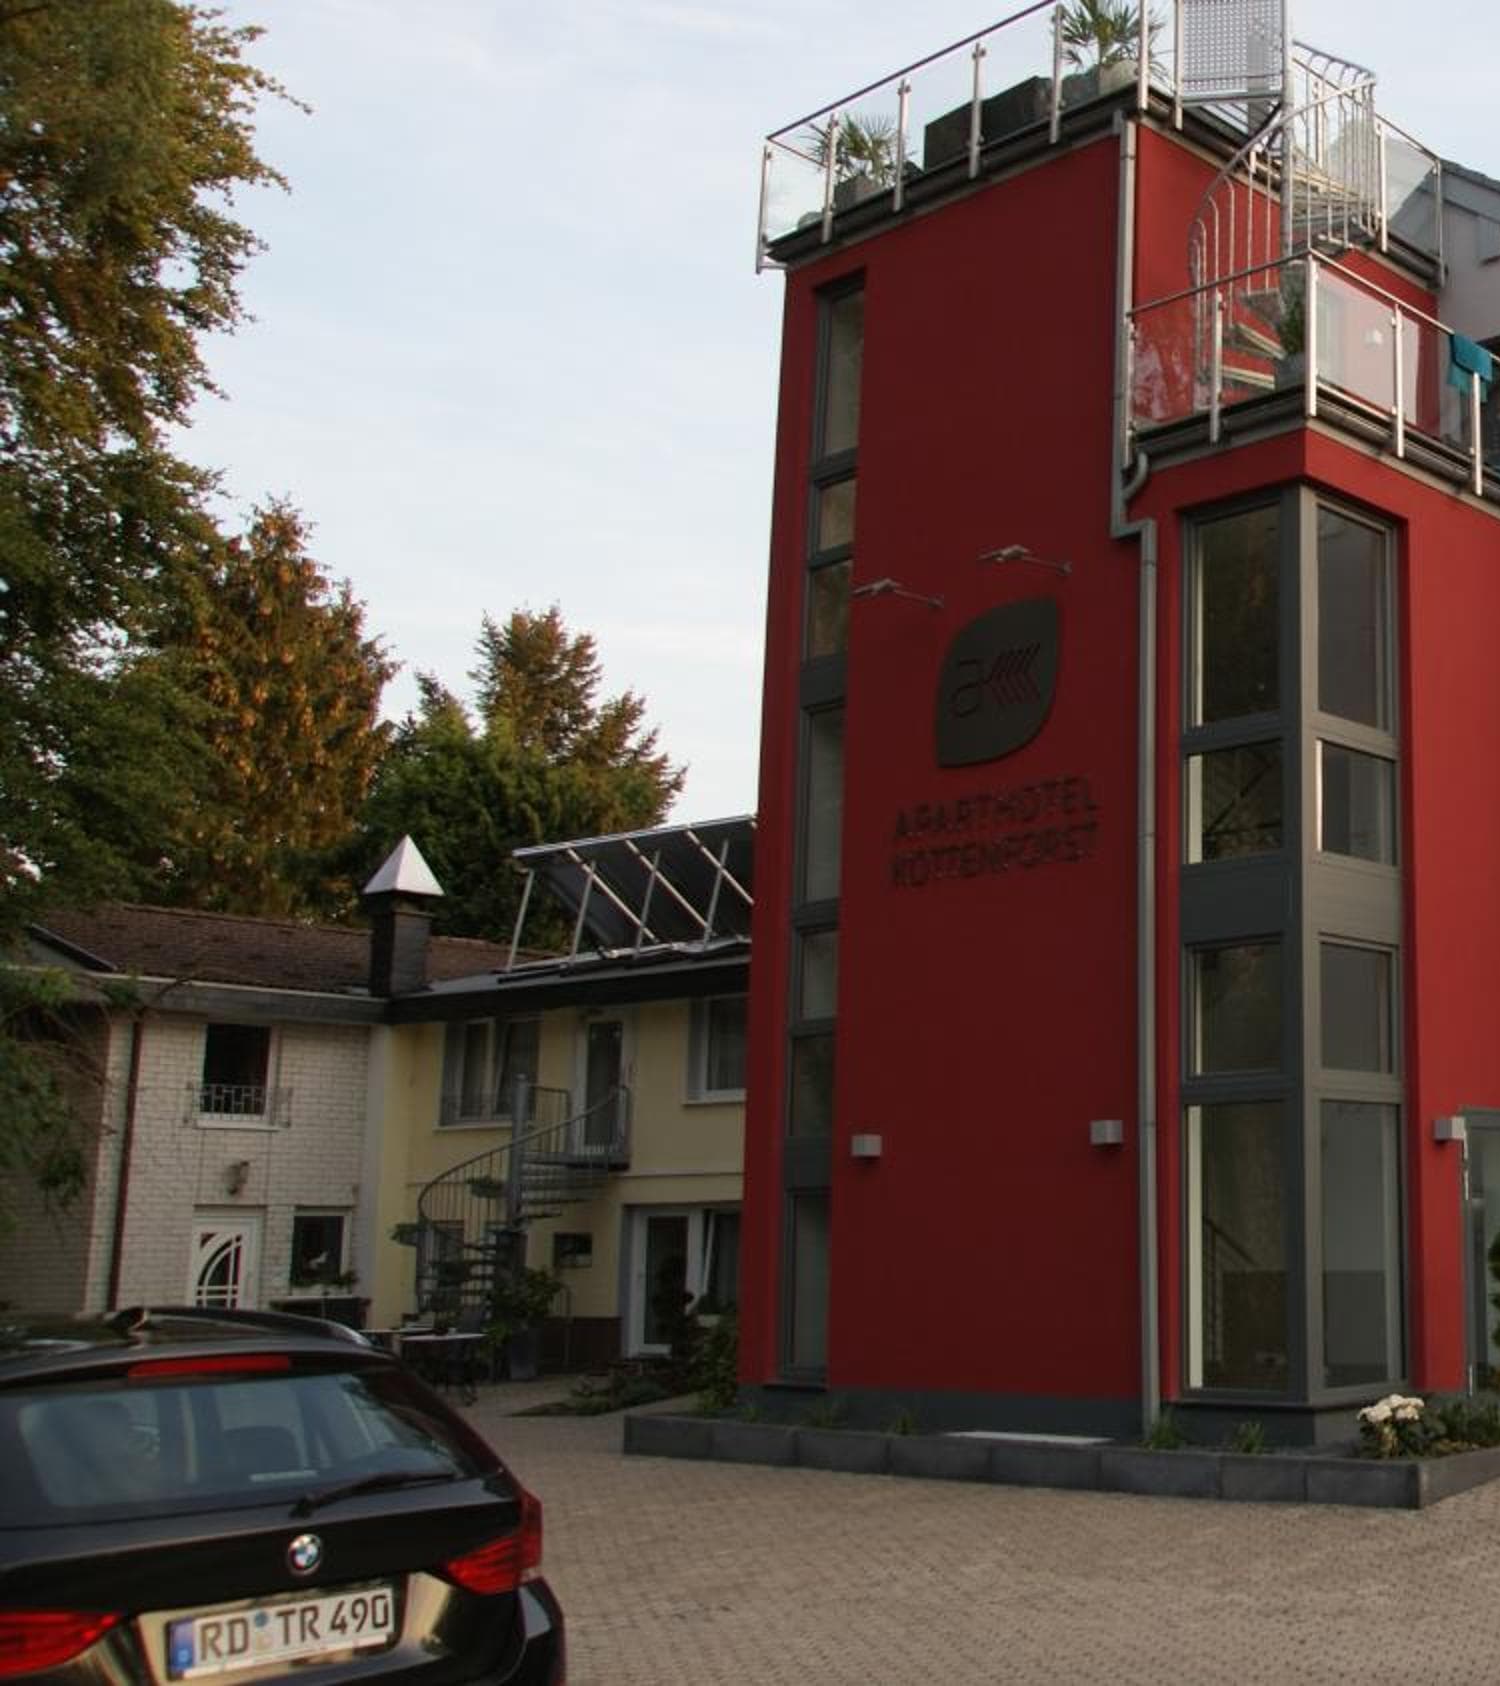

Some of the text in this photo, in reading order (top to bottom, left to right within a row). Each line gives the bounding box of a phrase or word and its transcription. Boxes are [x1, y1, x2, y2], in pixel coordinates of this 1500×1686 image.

[894, 776, 1099, 840] APARTHOTEL
[200, 1617, 249, 1661] RD
[276, 1605, 320, 1647] TR
[330, 1594, 390, 1635] 490
